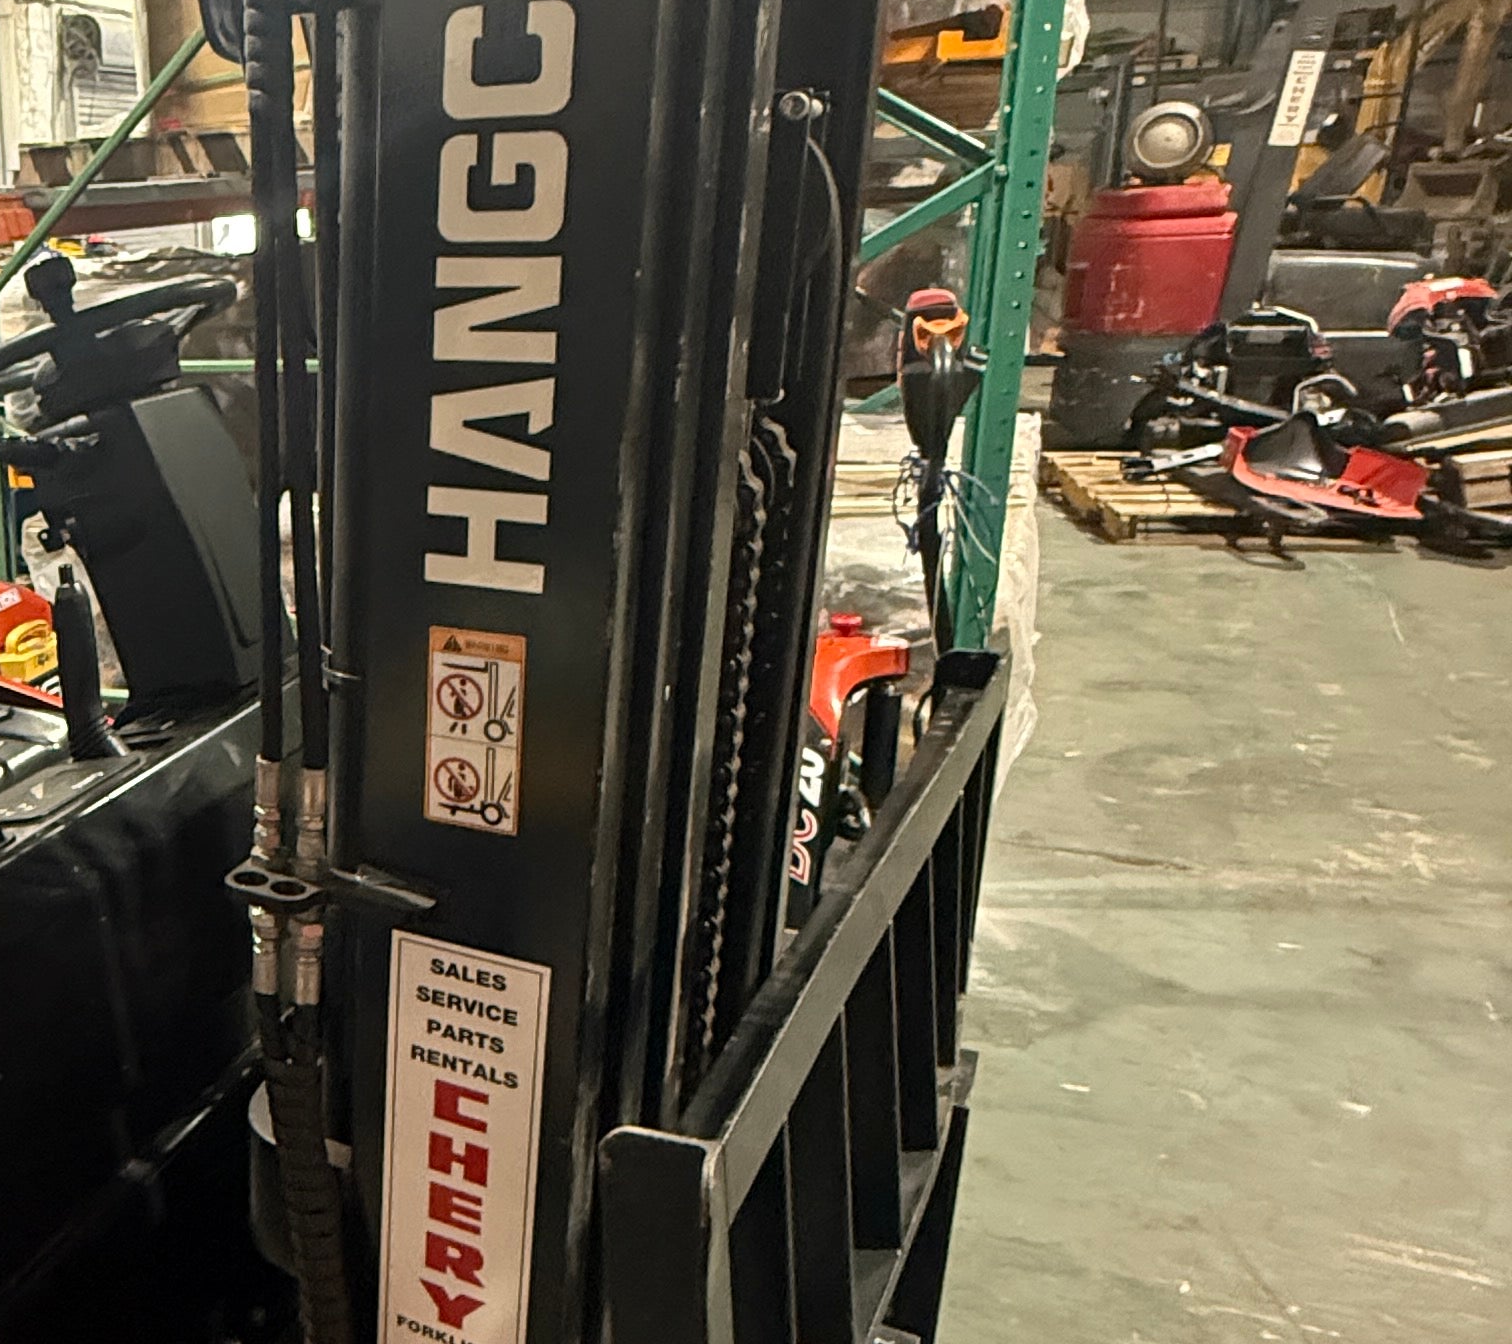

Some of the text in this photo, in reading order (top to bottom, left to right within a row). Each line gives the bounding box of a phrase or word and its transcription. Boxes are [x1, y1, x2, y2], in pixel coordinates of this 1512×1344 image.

[430, 958, 507, 991] SALES
[416, 985, 518, 1026] SERVICE
[426, 1019, 504, 1054] PARTS
[410, 1044, 519, 1089] RENTALS
[419, 1079, 489, 1330] CHERY
